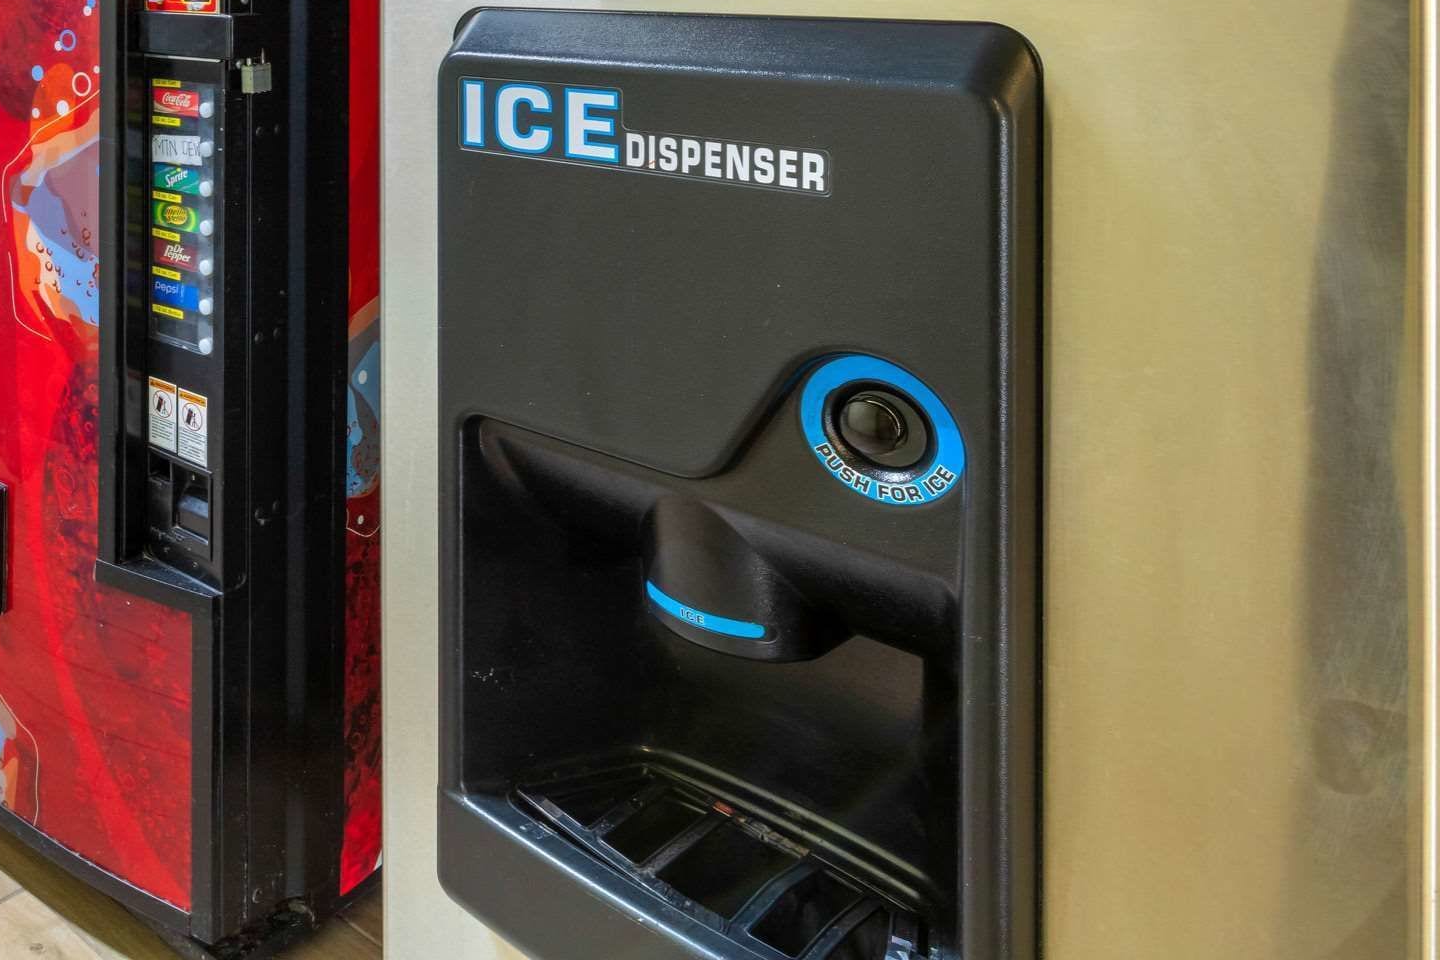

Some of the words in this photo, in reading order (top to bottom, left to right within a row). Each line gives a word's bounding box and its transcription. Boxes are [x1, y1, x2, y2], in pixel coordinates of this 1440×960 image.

[462, 79, 620, 164] ICE
[625, 132, 826, 192] DISPENSER
[164, 169, 189, 188] Sprite
[163, 244, 191, 263] Pepper
[172, 243, 185, 253] Dr
[814, 442, 872, 494] PUSH
[876, 483, 924, 502] FOR
[921, 464, 955, 496] ICE
[680, 607, 705, 626] ICE
